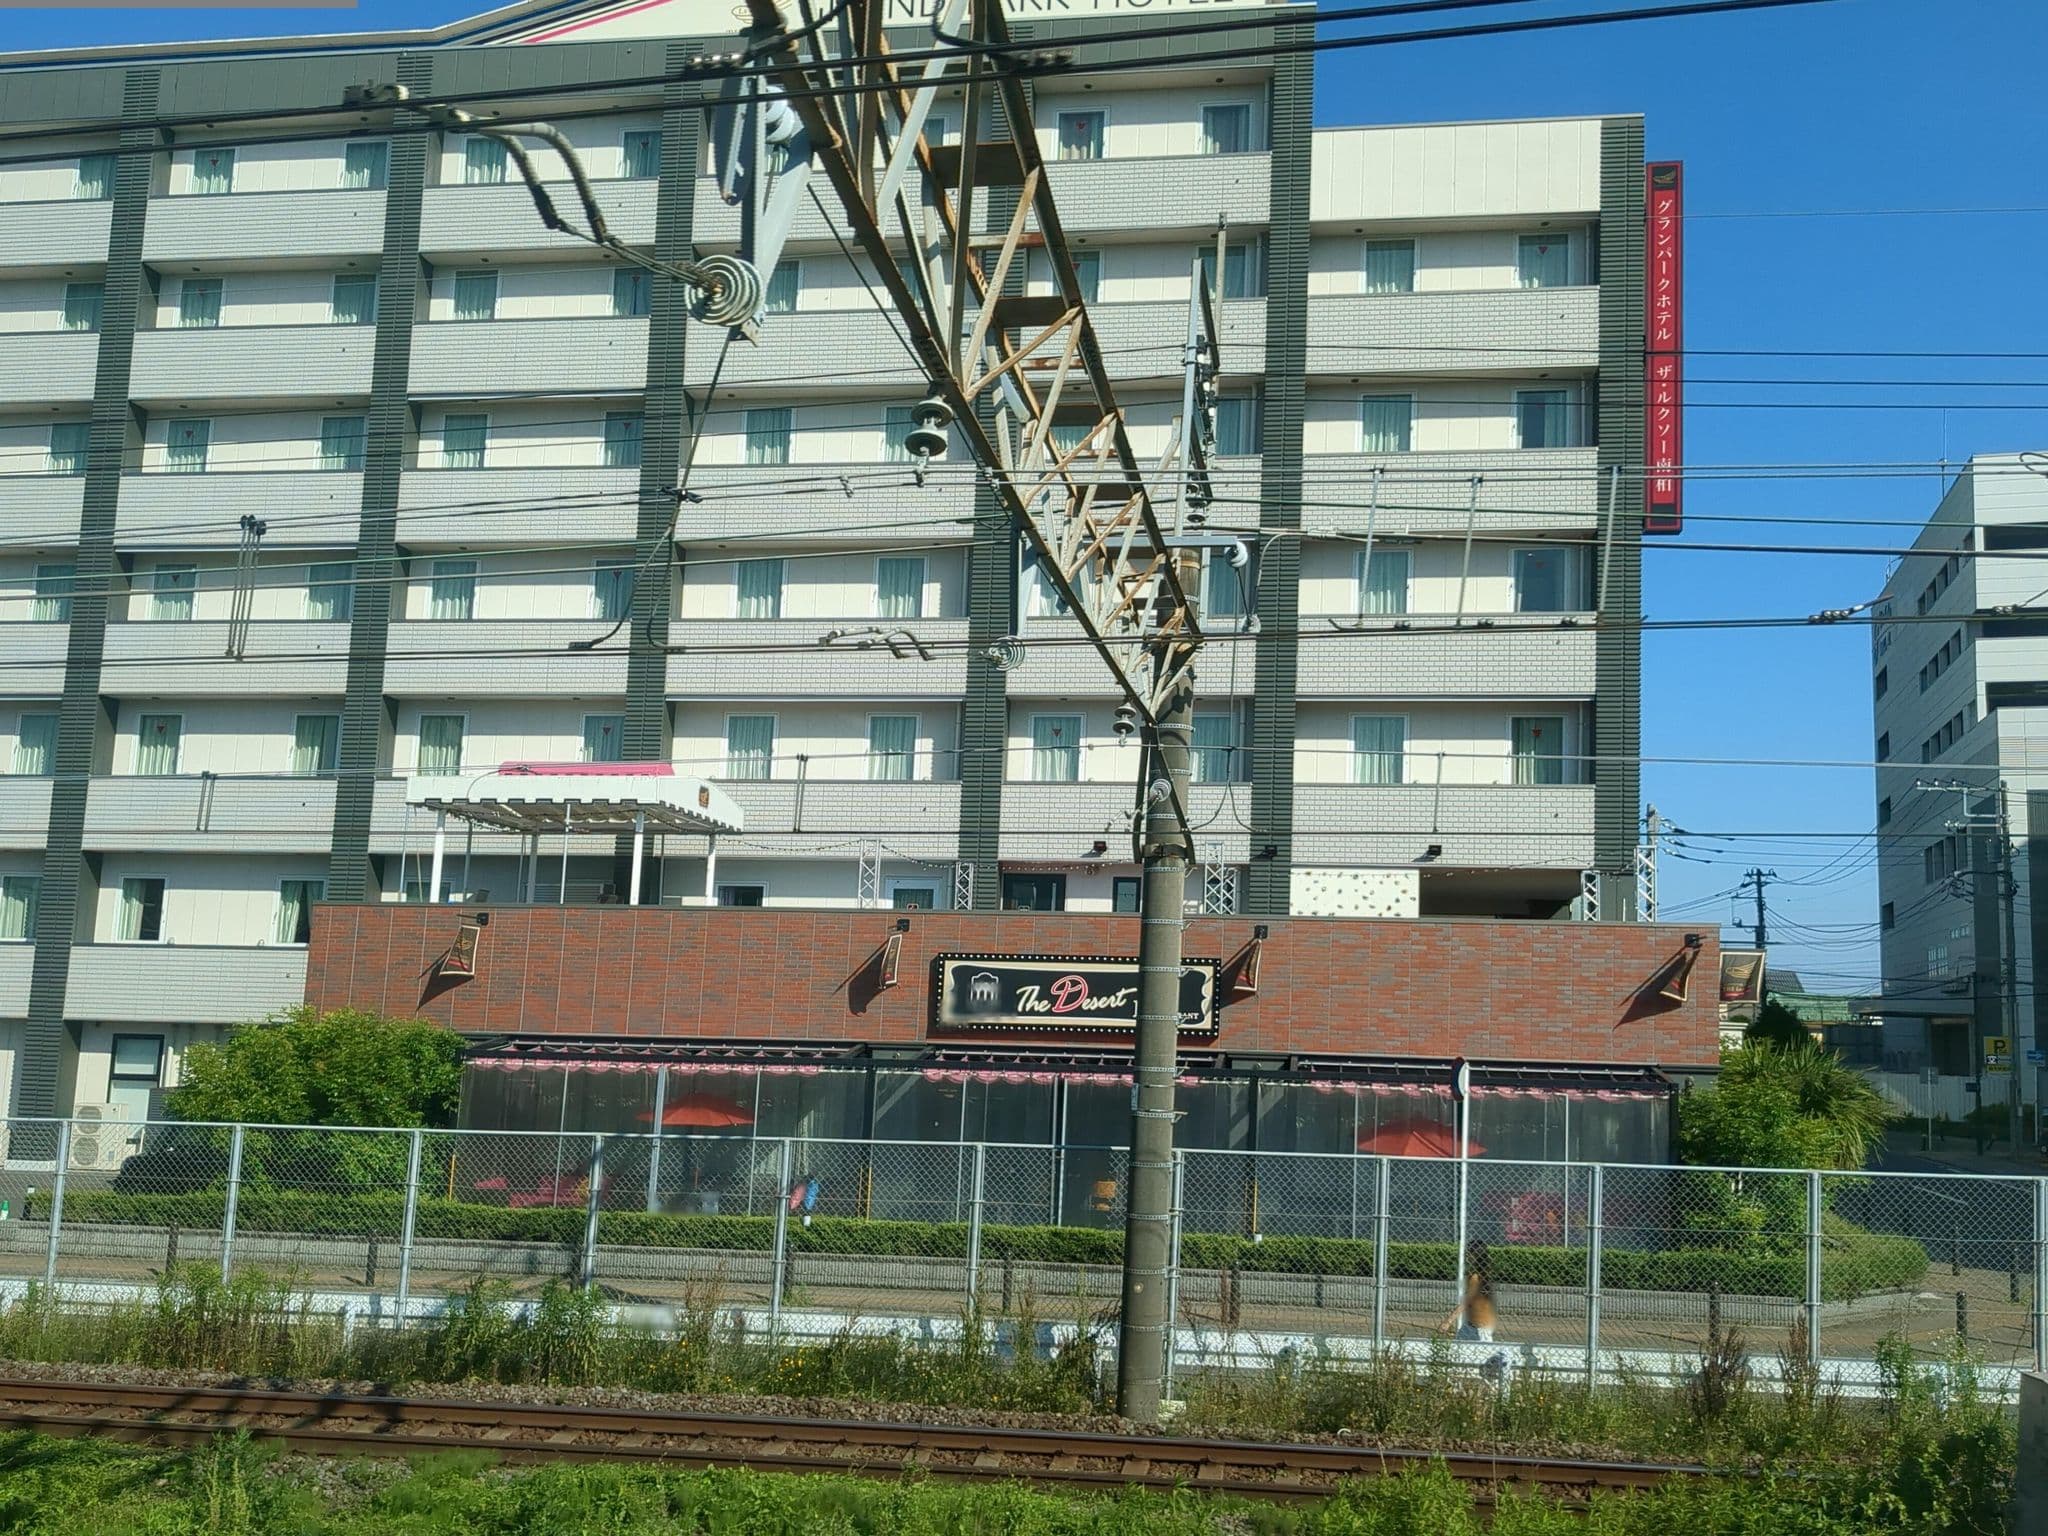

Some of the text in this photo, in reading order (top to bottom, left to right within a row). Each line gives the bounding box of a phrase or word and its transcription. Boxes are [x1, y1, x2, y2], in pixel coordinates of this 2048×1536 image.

[1656, 199, 1673, 341] グランパークホテル
[1016, 985, 1051, 1012] The
[1050, 974, 1138, 1013] Desert
[1993, 1039, 2006, 1054] P
